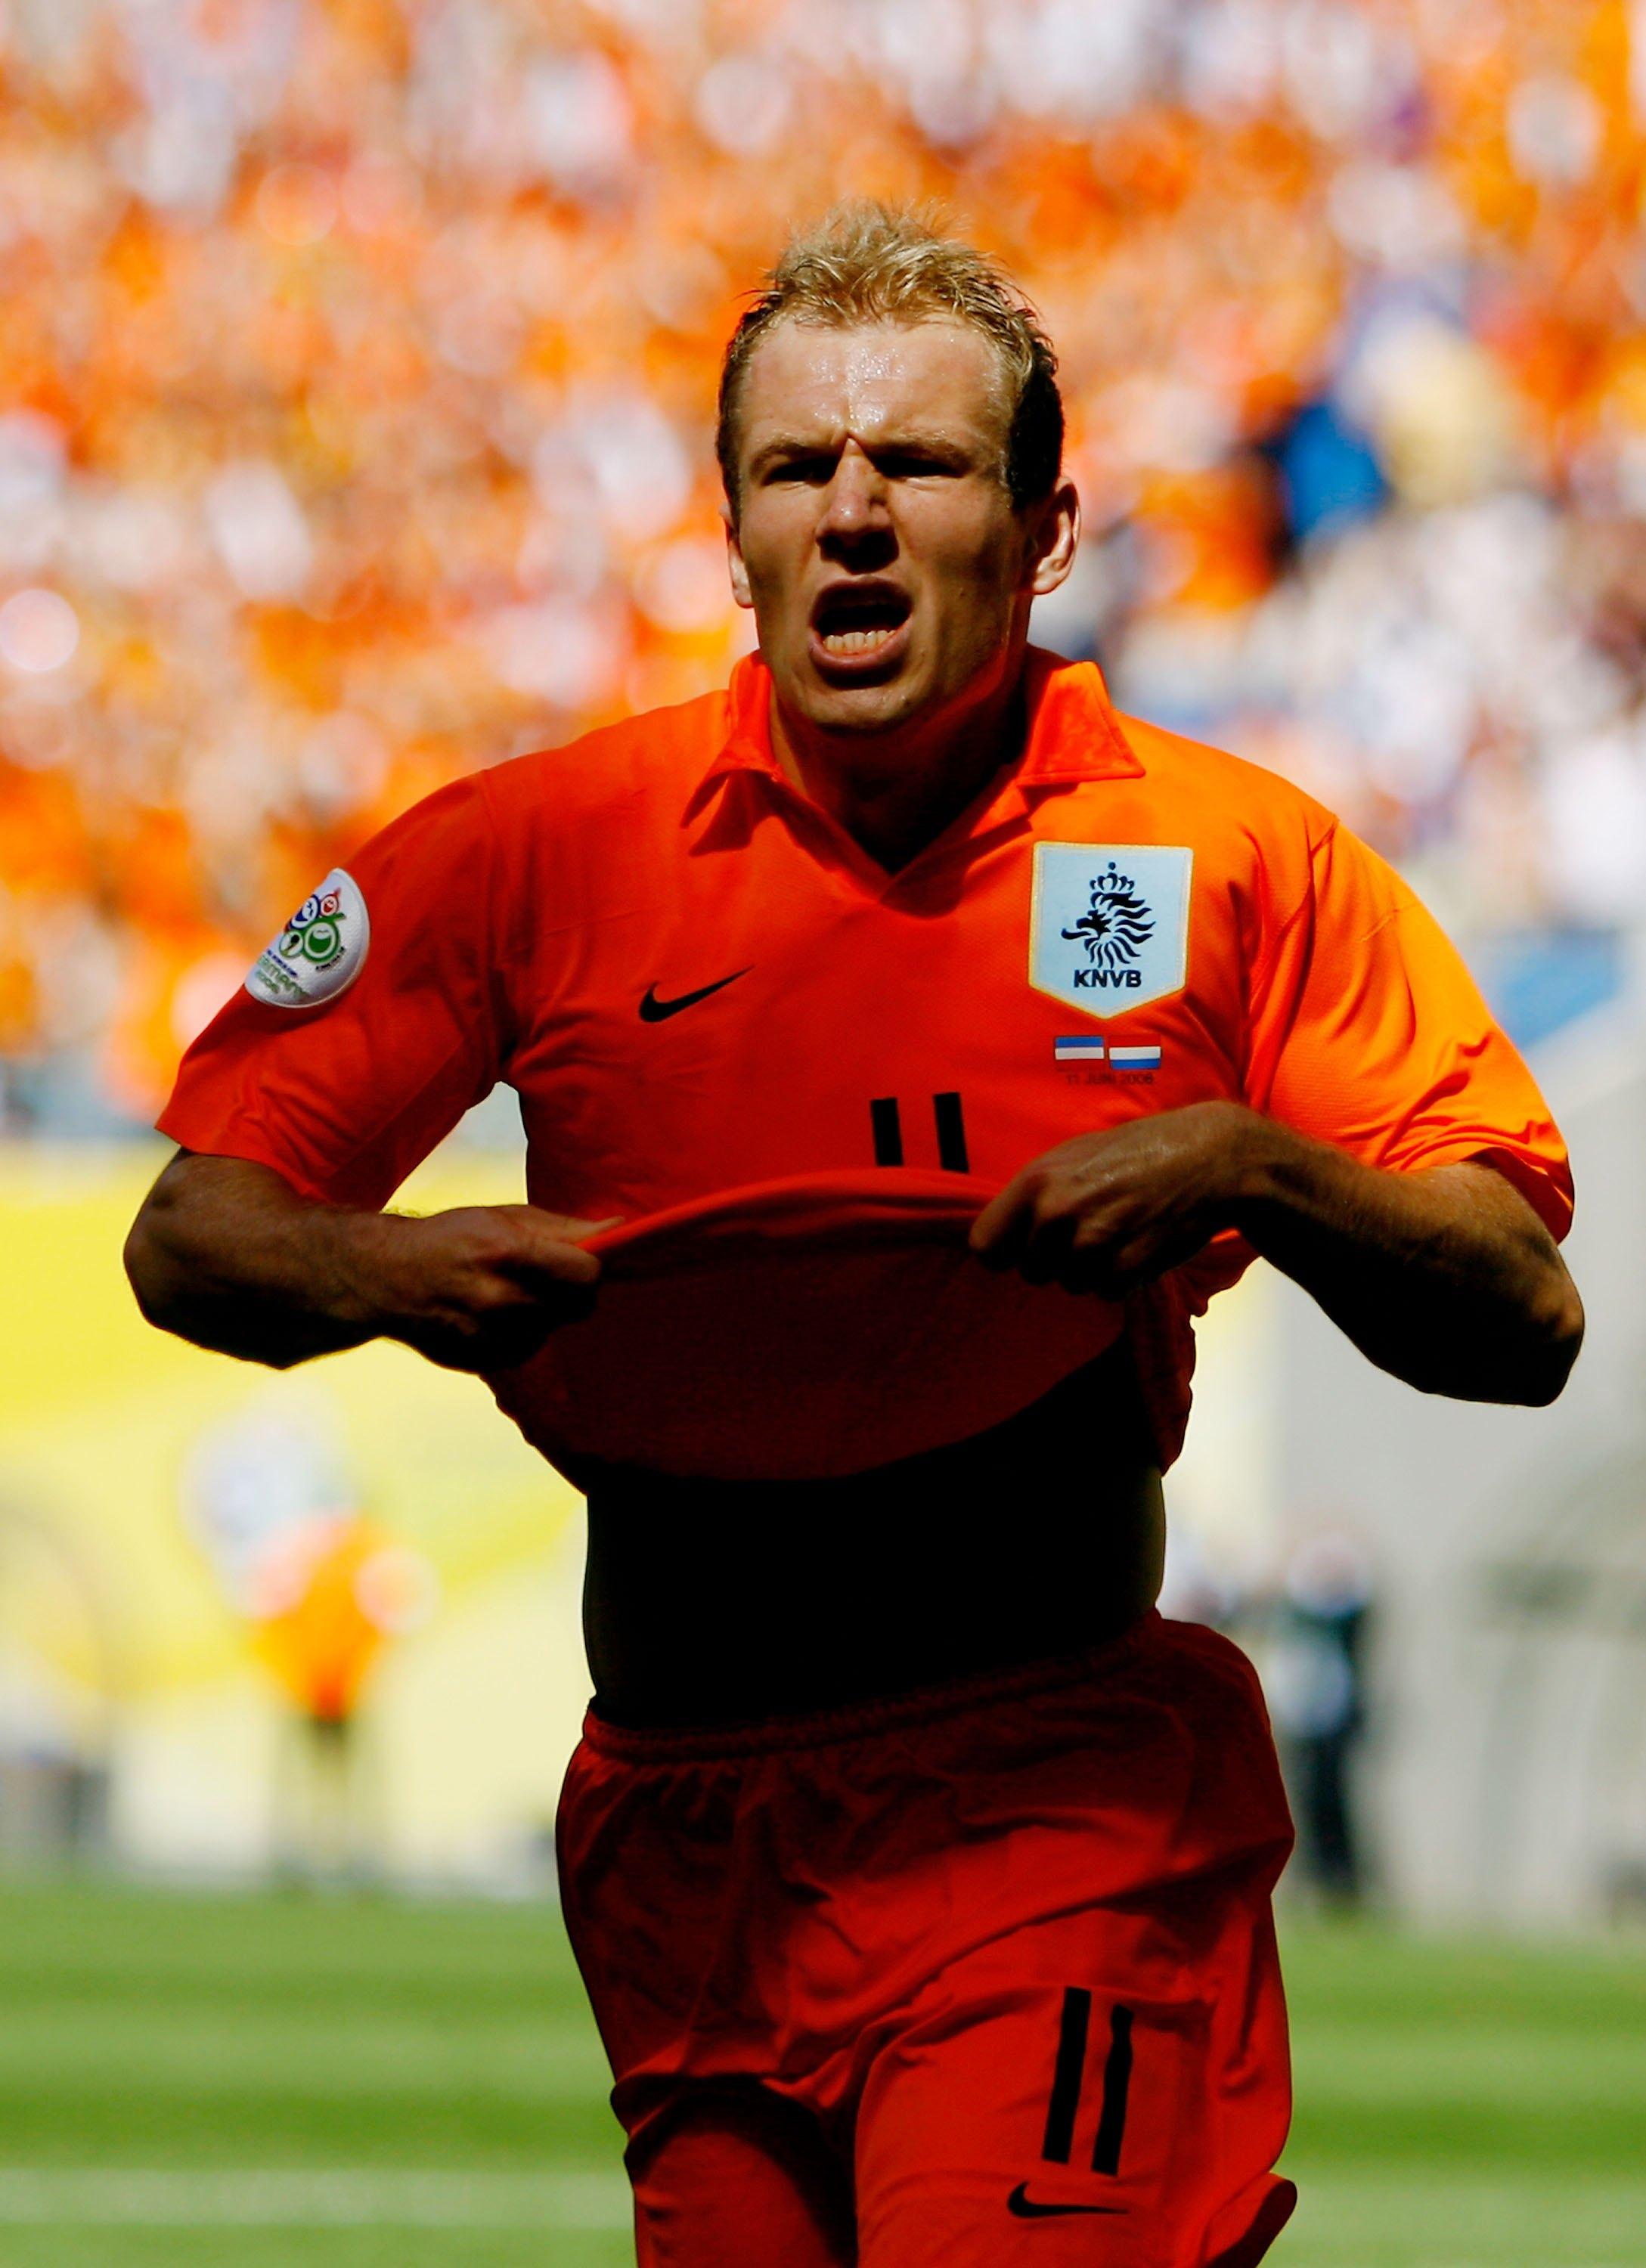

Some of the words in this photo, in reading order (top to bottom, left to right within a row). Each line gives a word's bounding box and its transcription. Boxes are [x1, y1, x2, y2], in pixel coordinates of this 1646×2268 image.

[1074, 968, 1142, 988] KNVB
[870, 1091, 970, 1174] 11
[1041, 1985, 1134, 2177] 11
